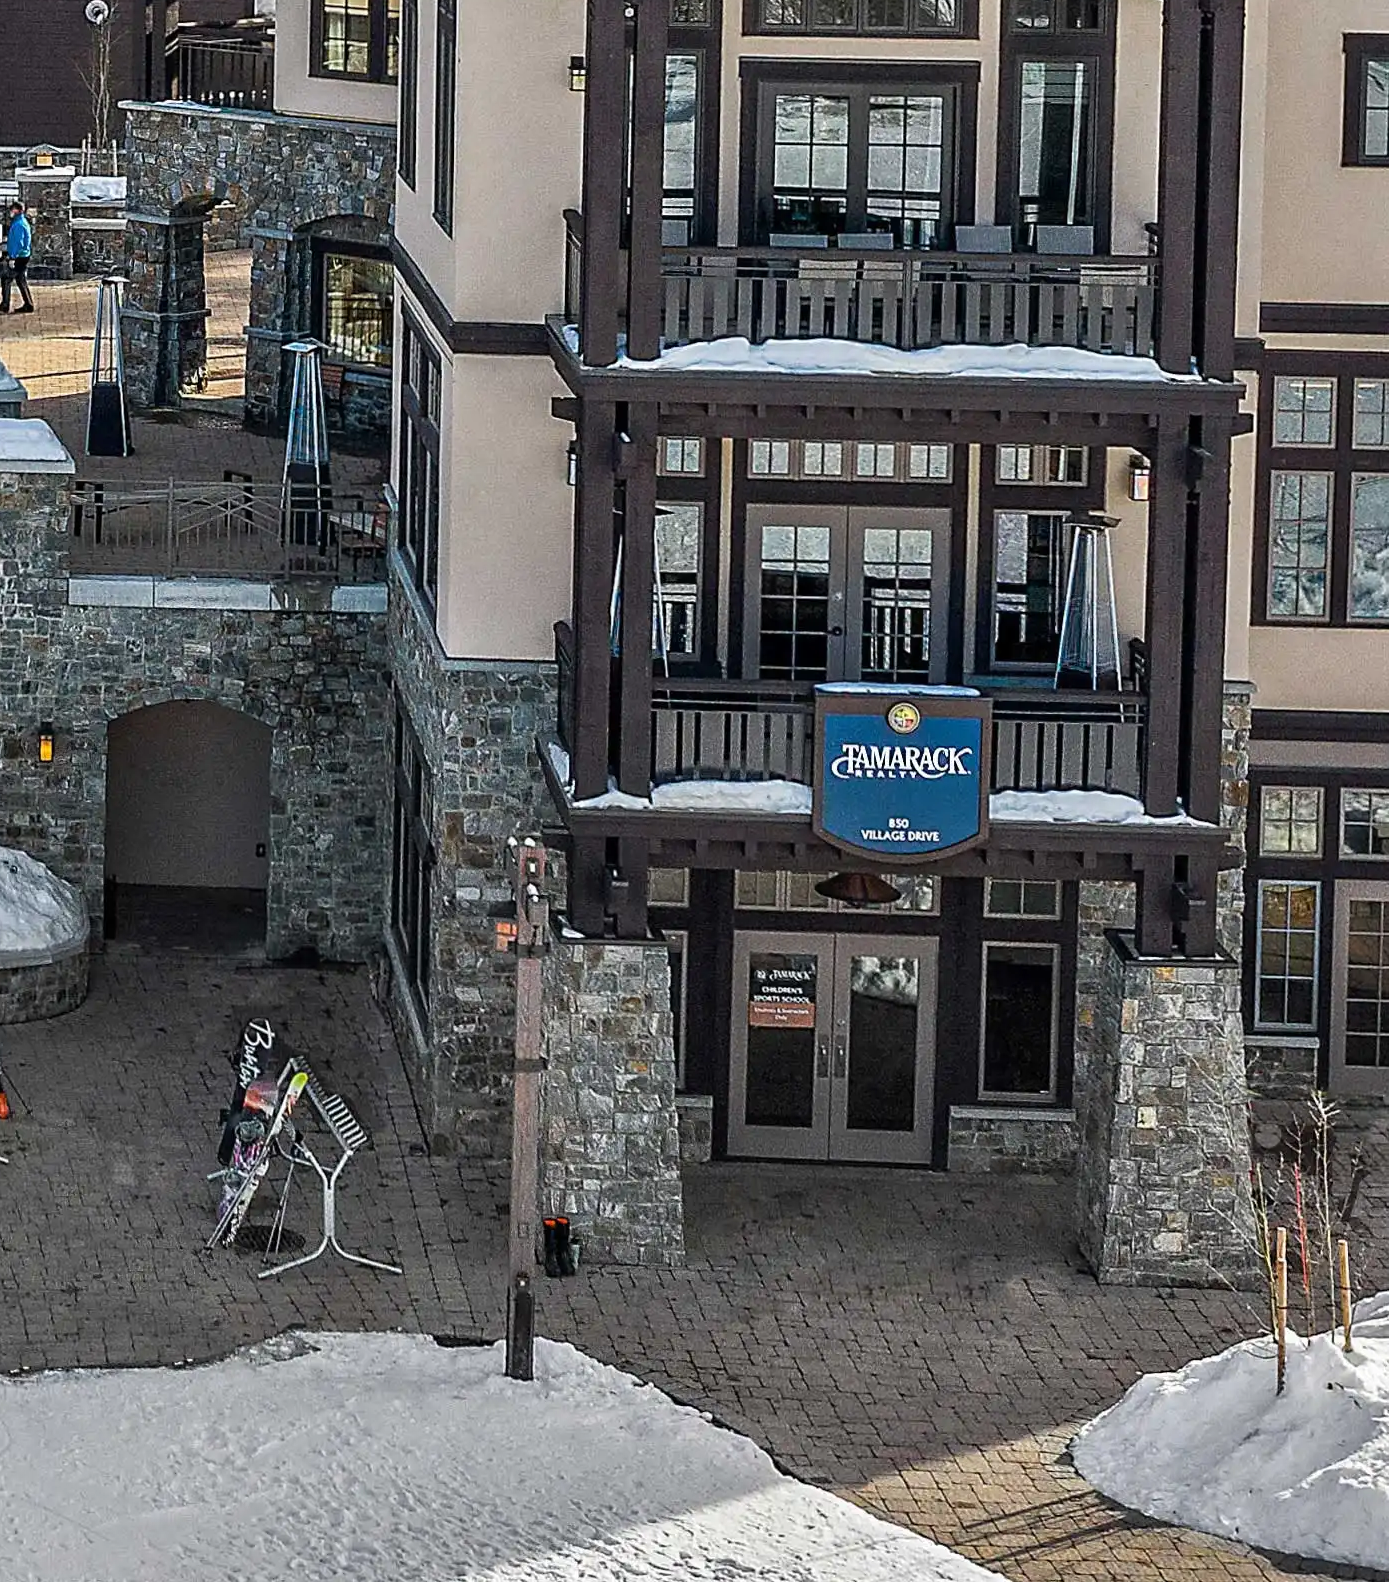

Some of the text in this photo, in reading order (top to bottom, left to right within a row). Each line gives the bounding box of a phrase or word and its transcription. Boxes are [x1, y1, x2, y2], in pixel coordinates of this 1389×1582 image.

[831, 744, 973, 779] TAMARACK
[855, 769, 918, 779] REALTY
[888, 818, 910, 829] 850
[861, 829, 940, 842] VILLAGE DRIVE
